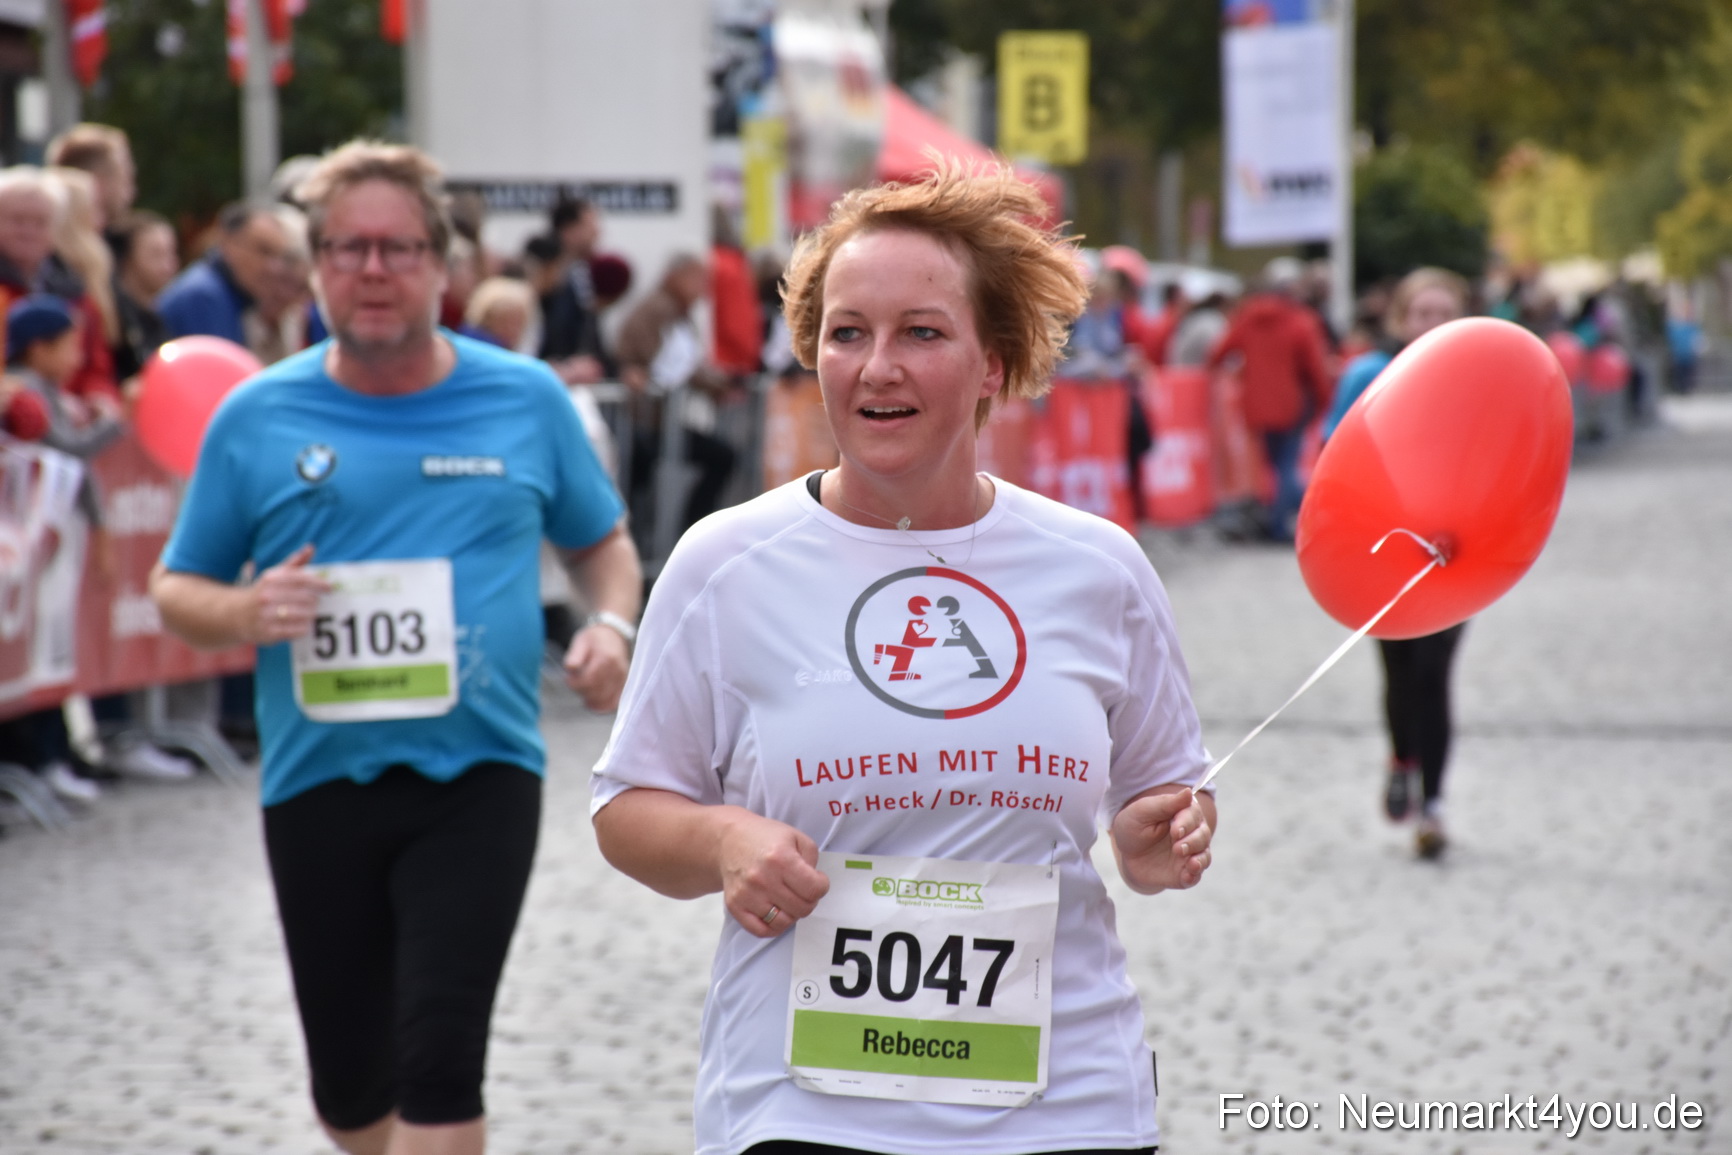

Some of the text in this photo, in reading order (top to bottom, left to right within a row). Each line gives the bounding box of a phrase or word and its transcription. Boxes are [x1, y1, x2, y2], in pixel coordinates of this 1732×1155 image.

[313, 610, 427, 661] 5103
[828, 800, 859, 817] Dr.
[865, 791, 925, 812] Heck
[949, 790, 982, 806] Dr.
[990, 790, 1063, 813] Röschl
[896, 879, 983, 903] BOCK
[829, 927, 1015, 1008] 5047
[803, 986, 812, 1000] S
[862, 1028, 971, 1060] Rebecca
